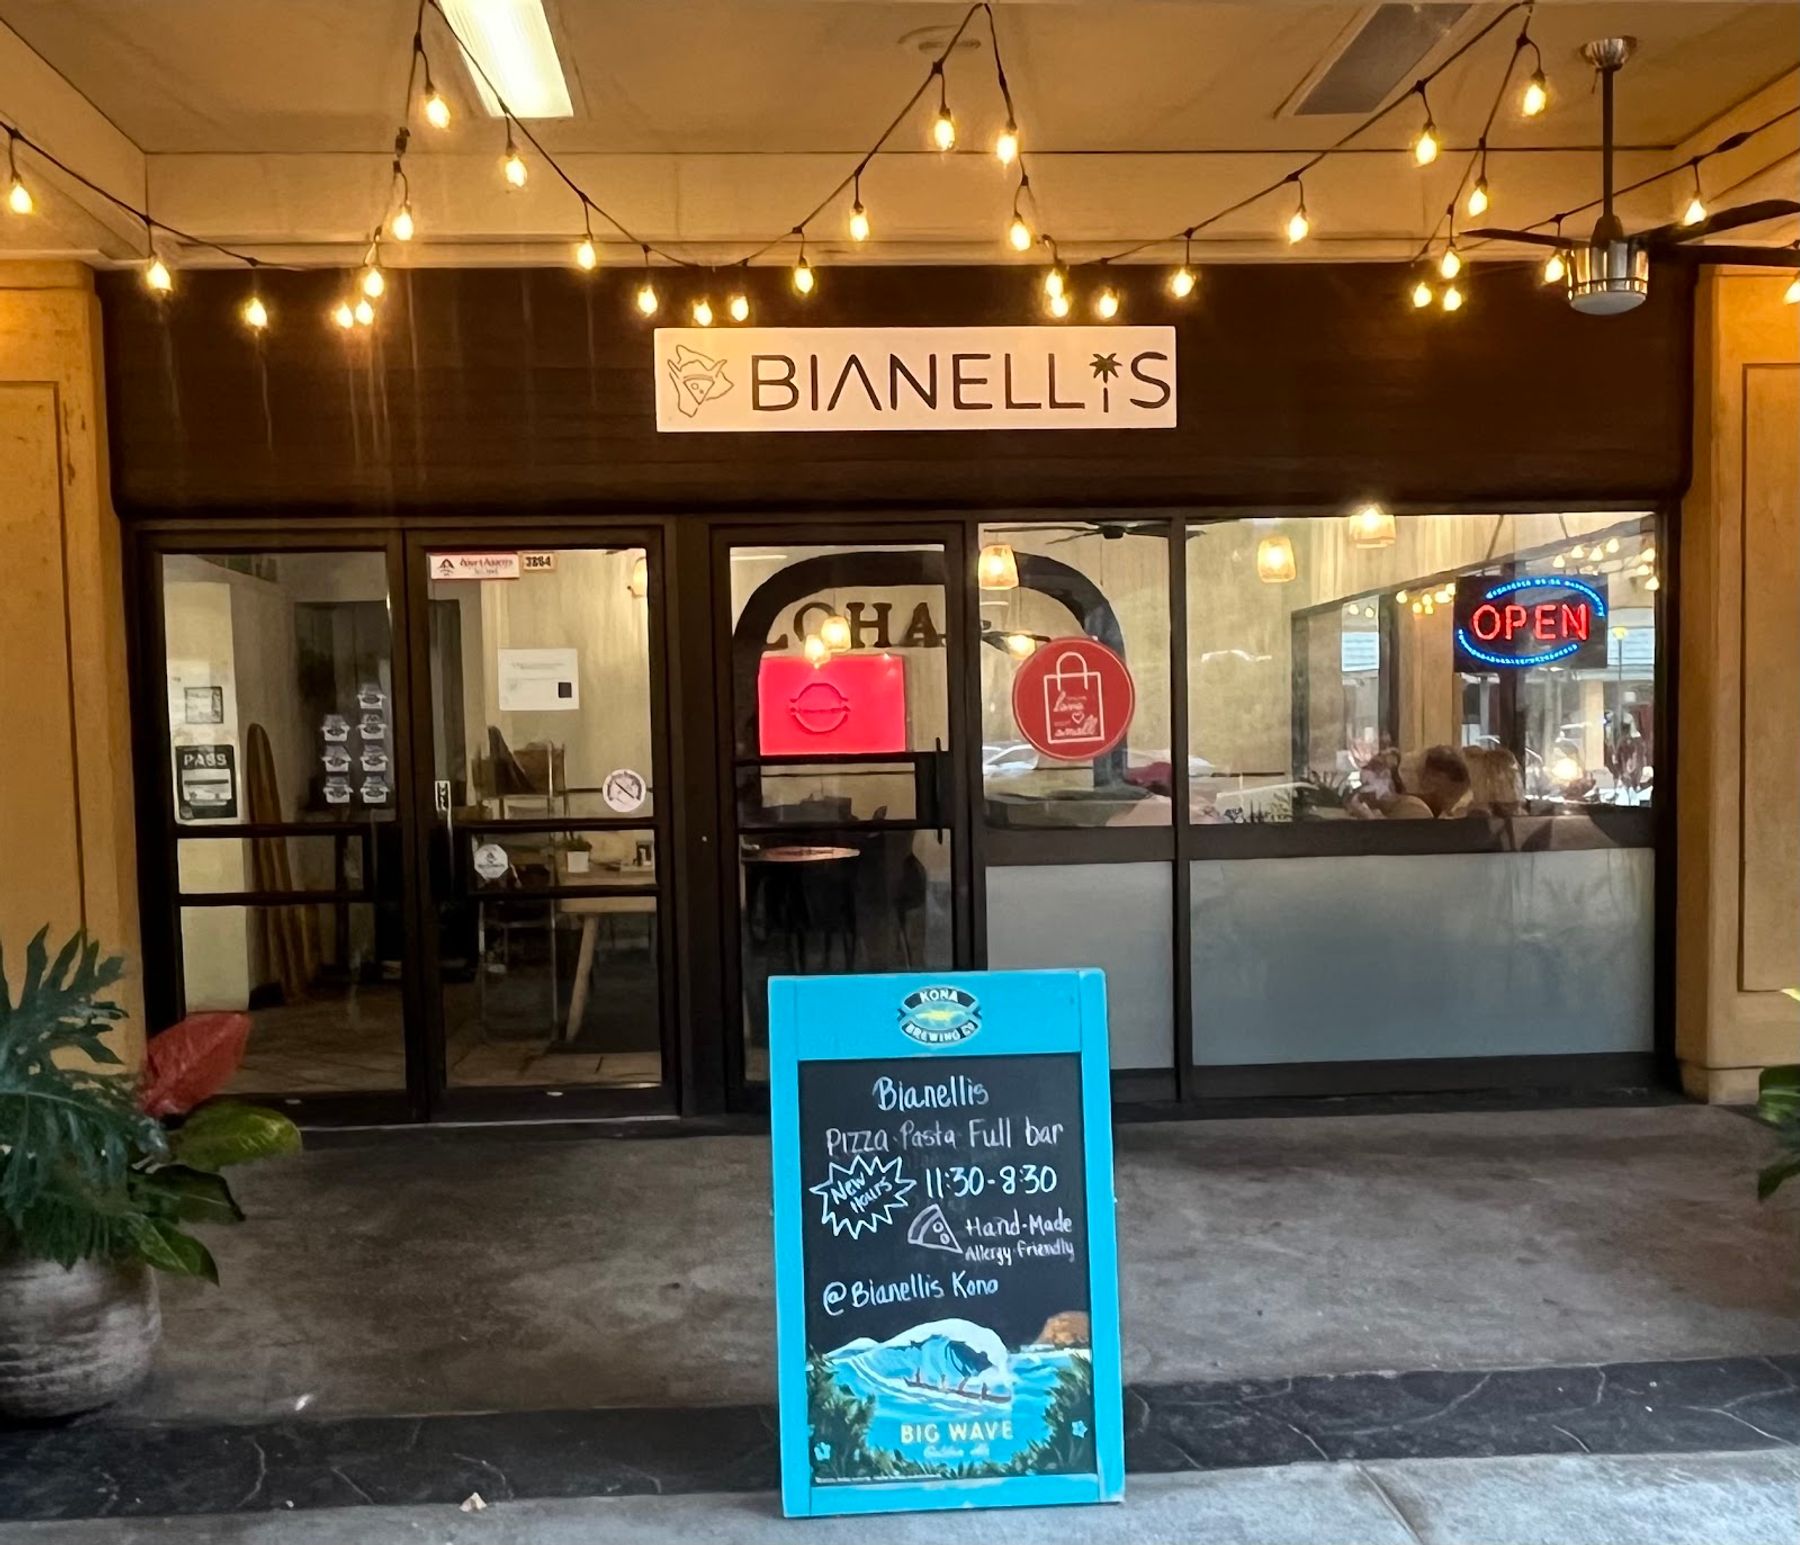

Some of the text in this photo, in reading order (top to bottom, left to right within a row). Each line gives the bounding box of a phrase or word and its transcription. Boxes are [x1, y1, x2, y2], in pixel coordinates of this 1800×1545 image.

[1472, 604, 1588, 641] OPEN
[184, 753, 227, 767] PASS
[920, 989, 958, 1003] KONA
[905, 1022, 960, 1042] BREWING
[872, 1075, 989, 1111] Bianellis
[900, 1120, 956, 1150] Pasta
[969, 1117, 1011, 1148] Full
[1025, 1115, 1063, 1147] bar
[830, 1171, 866, 1205] New
[849, 1176, 893, 1213] Hours
[900, 1420, 1014, 1444] BIG WAVE
